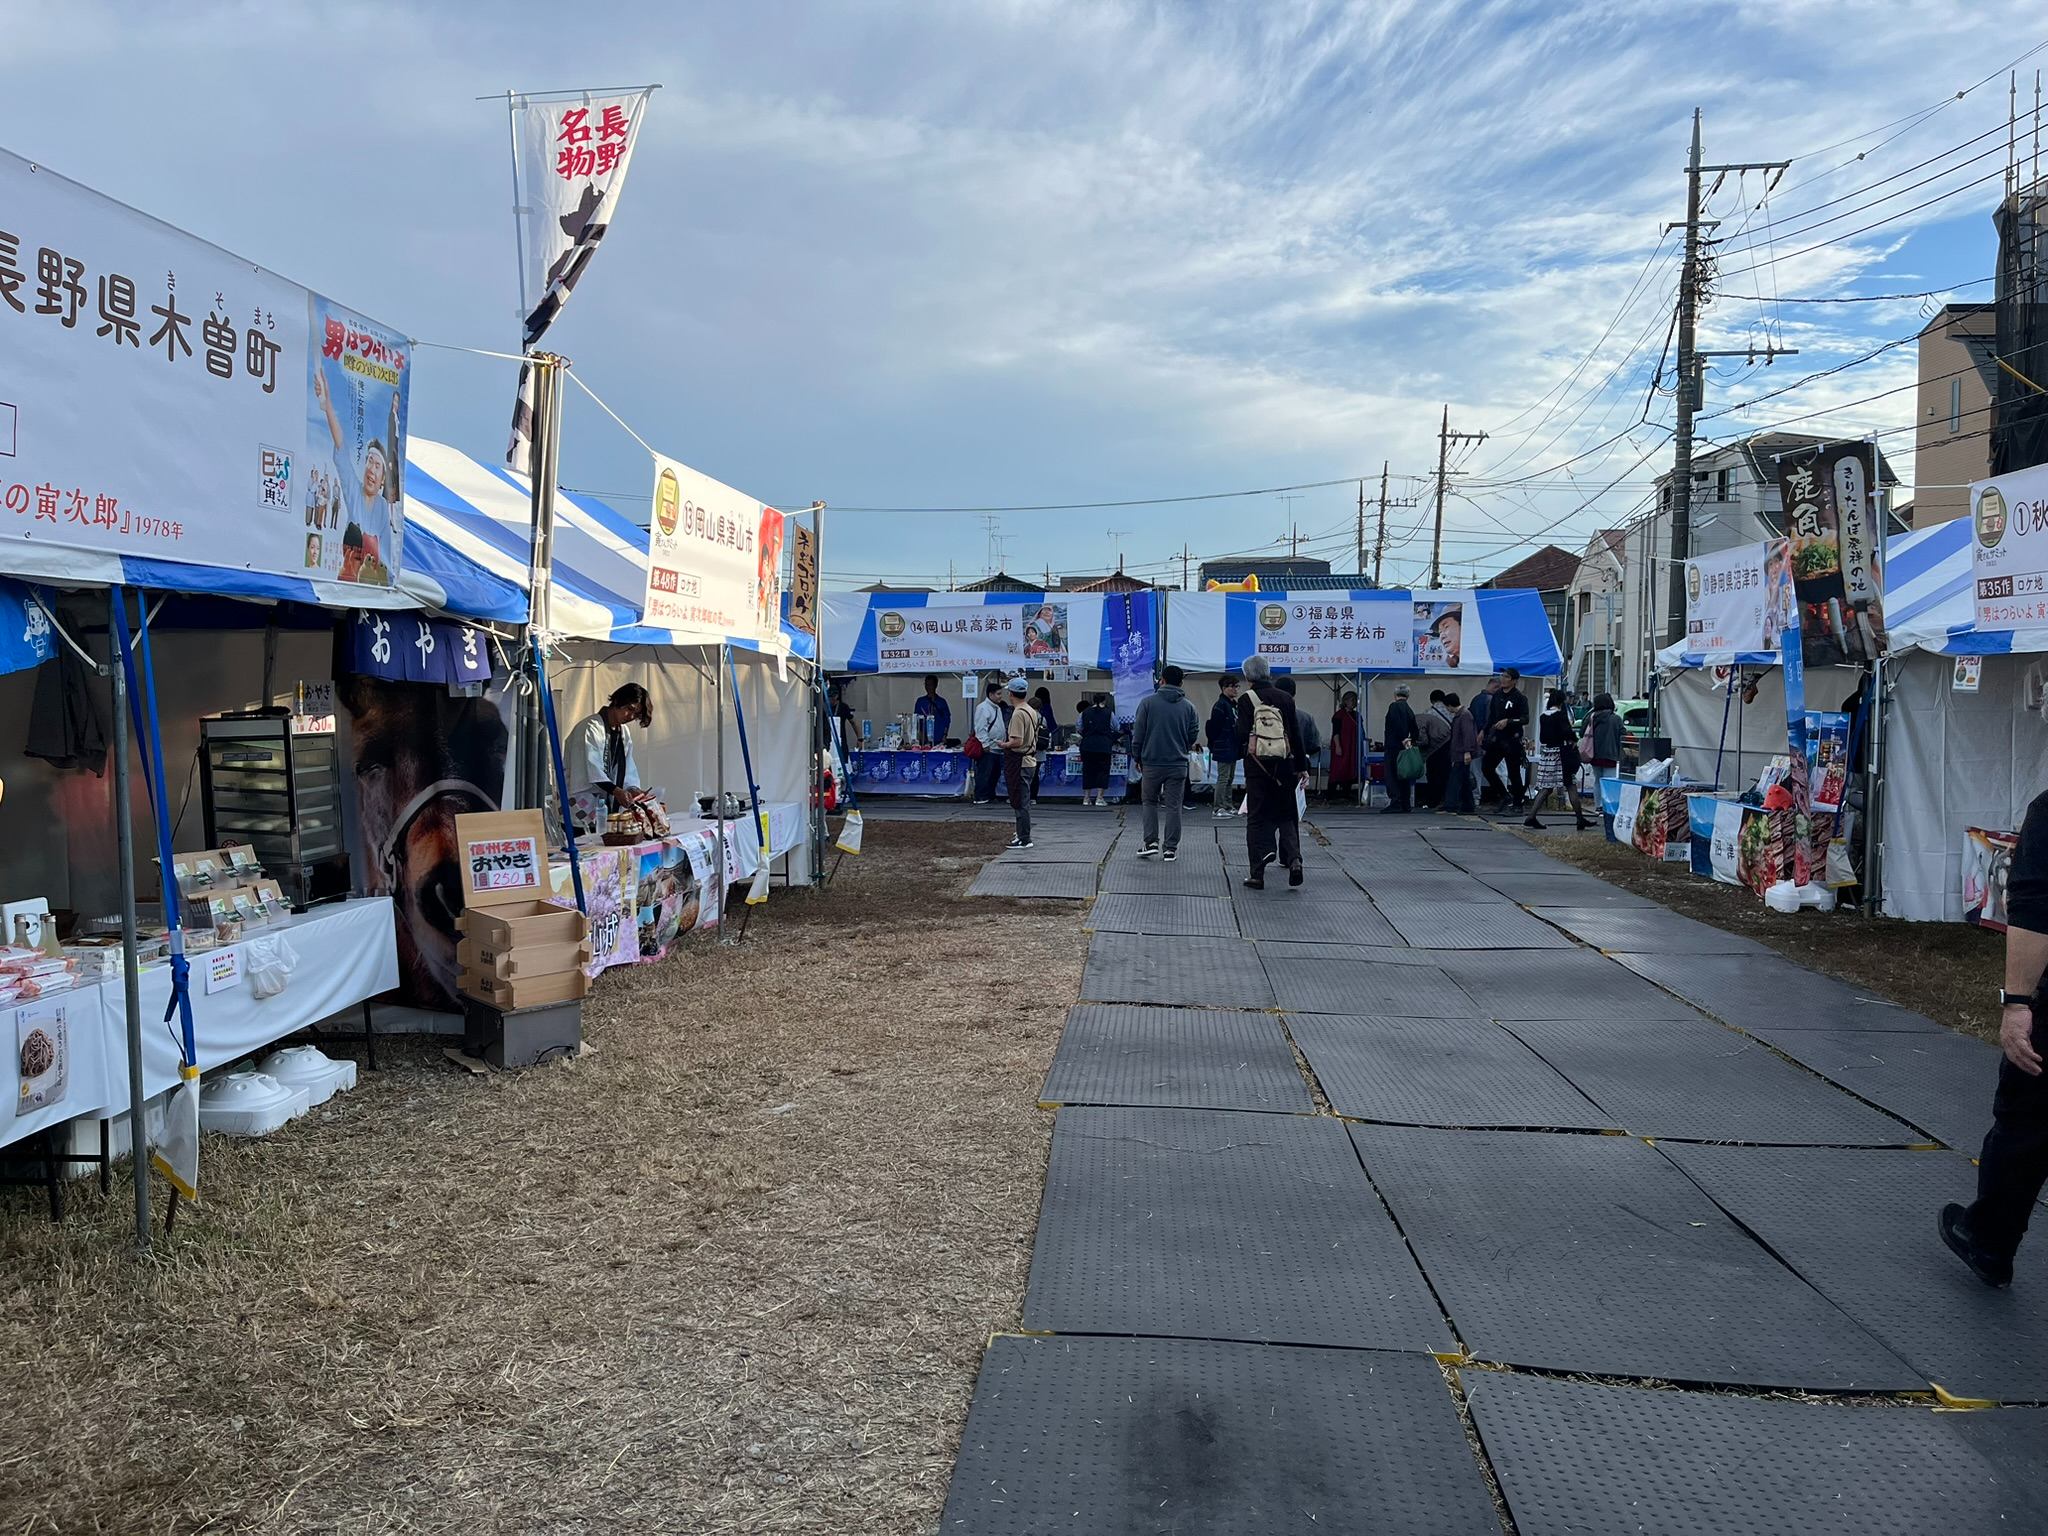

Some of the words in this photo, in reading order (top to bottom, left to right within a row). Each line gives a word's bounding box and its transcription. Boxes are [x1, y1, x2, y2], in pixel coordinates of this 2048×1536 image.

[556, 107, 595, 181] 名物
[595, 105, 630, 176] 長野
[0, 231, 282, 394] 長野県木曽町
[215, 291, 224, 310] そ
[253, 307, 277, 331] まち
[322, 313, 405, 369] 男はつらいよ
[0, 480, 184, 540] の寅次郎』1978年
[1786, 466, 1823, 537] 鹿角
[1844, 467, 1868, 592] きりたんぽ発祥の地
[1979, 578, 2012, 598] 第35作
[2018, 575, 2044, 592] ロケ地
[2036, 602, 2048, 619] 寅
[372, 613, 478, 670] おやき
[1308, 625, 1387, 640] 会津若松市
[305, 684, 331, 700] おやき
[470, 840, 531, 857] 信州名物
[472, 854, 532, 873] おやき
